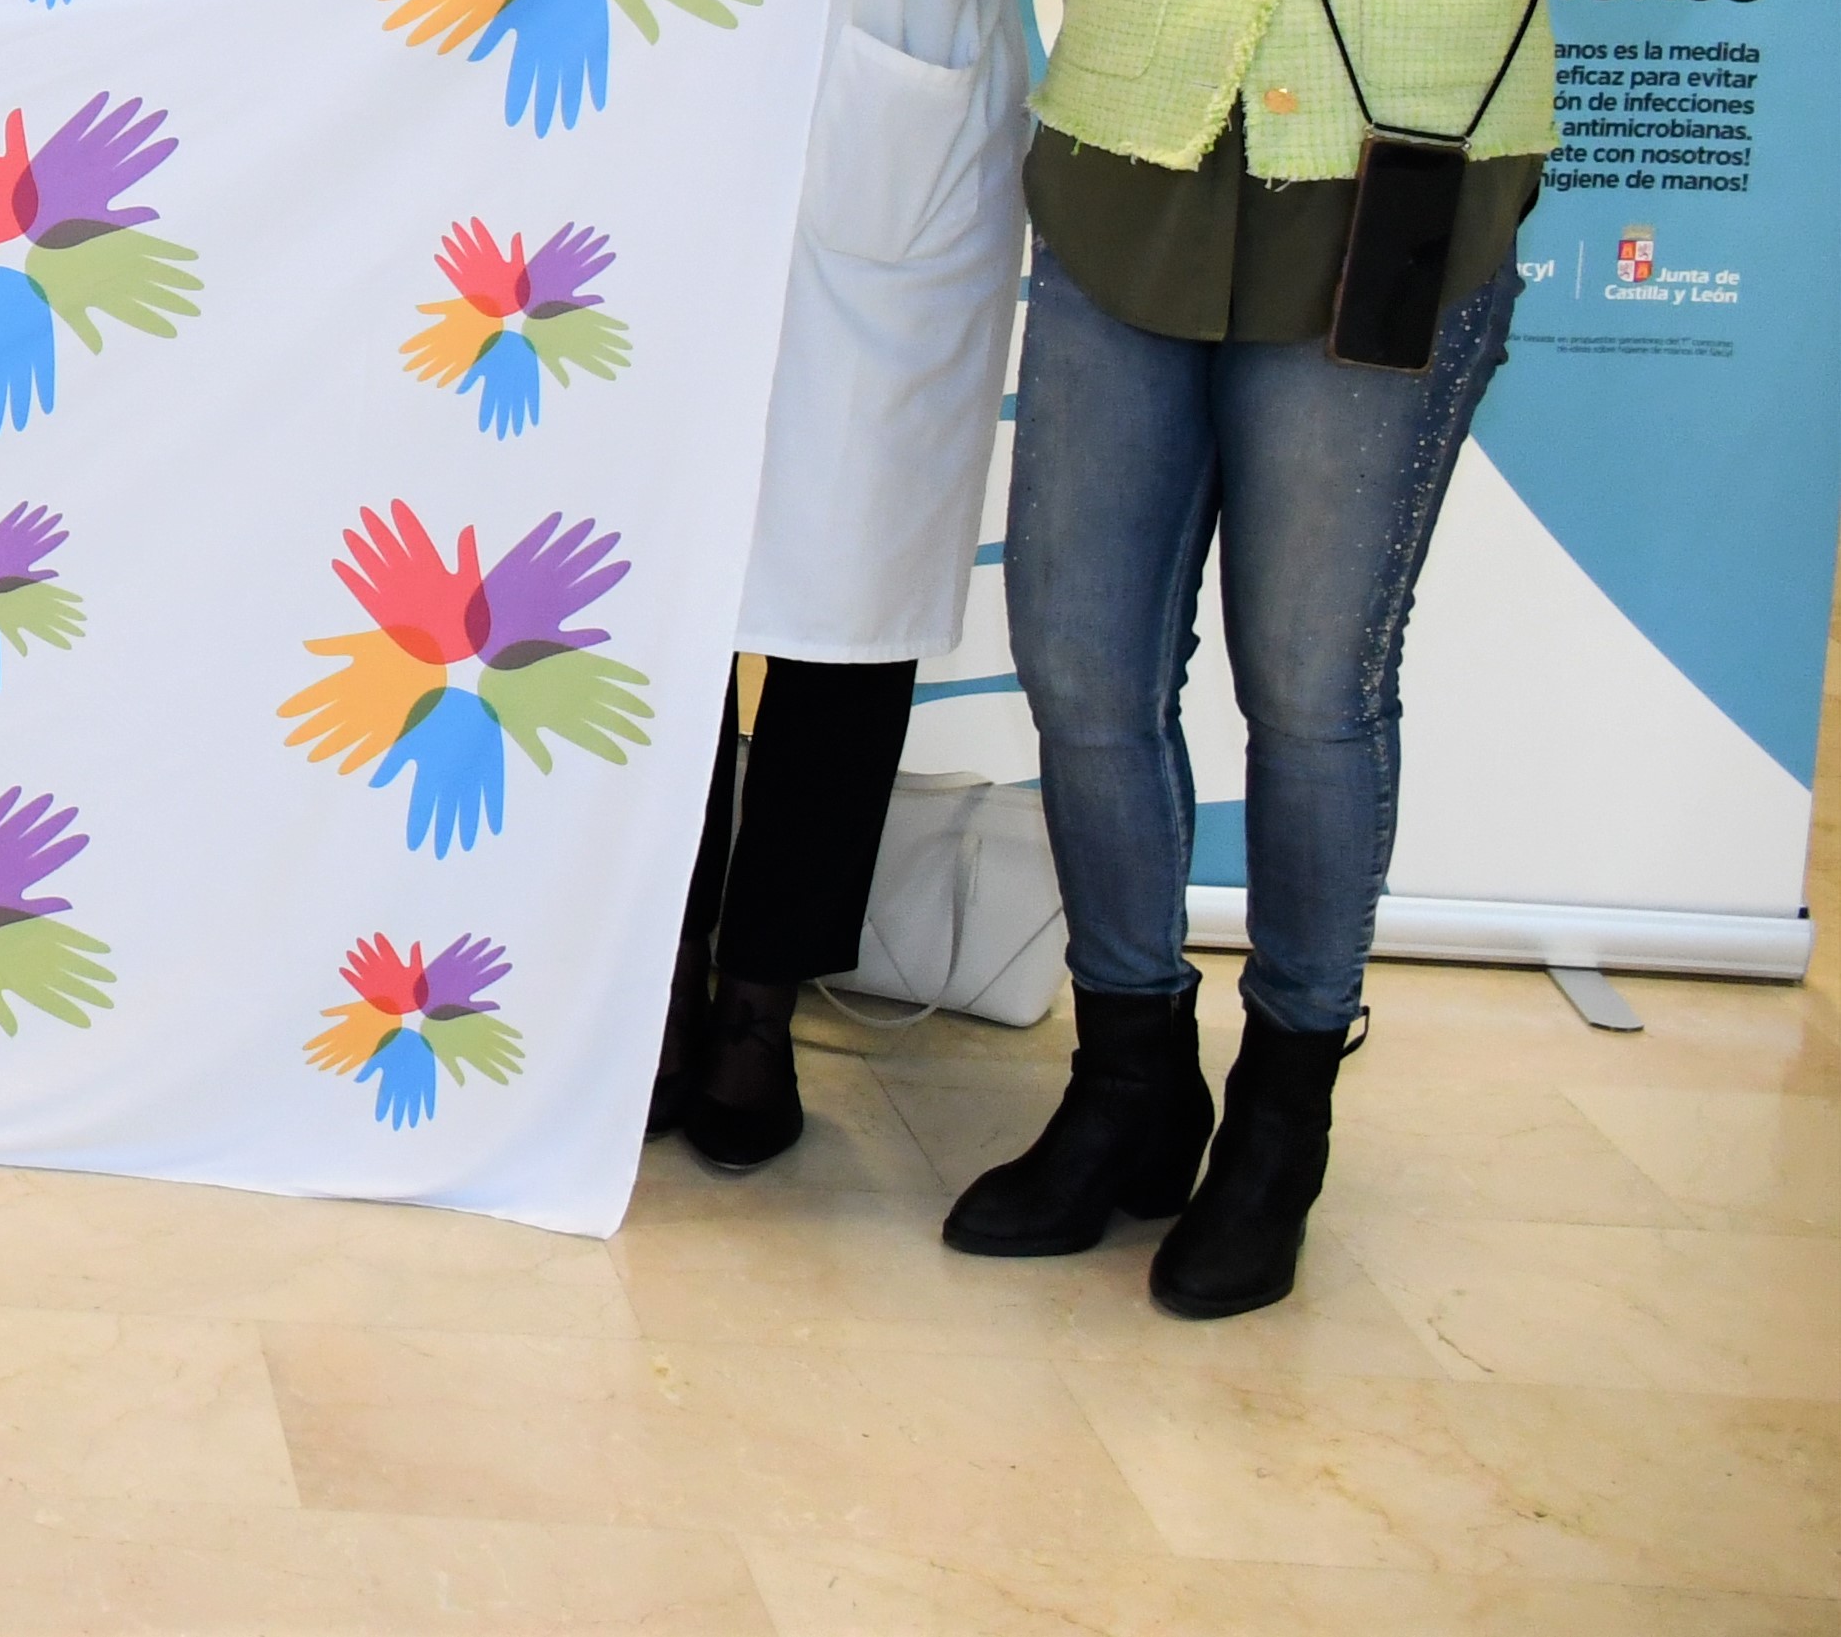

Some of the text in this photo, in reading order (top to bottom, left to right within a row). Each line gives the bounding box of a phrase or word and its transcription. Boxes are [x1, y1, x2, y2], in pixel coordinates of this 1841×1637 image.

[1555, 41, 1760, 63] anos es la medida
[1556, 65, 1758, 89] eficaz para evitar
[1588, 92, 1617, 111] de
[1624, 92, 1755, 115] infecciones
[1562, 118, 1753, 141] antimicrobianas.
[1594, 148, 1635, 164] con
[1641, 147, 1751, 166] nosotros!
[1626, 170, 1655, 189] de
[1661, 173, 1750, 192] manos!
[1656, 267, 1710, 284] Junta
[1715, 269, 1740, 286] de
[1604, 284, 1738, 305] Castilla y León
